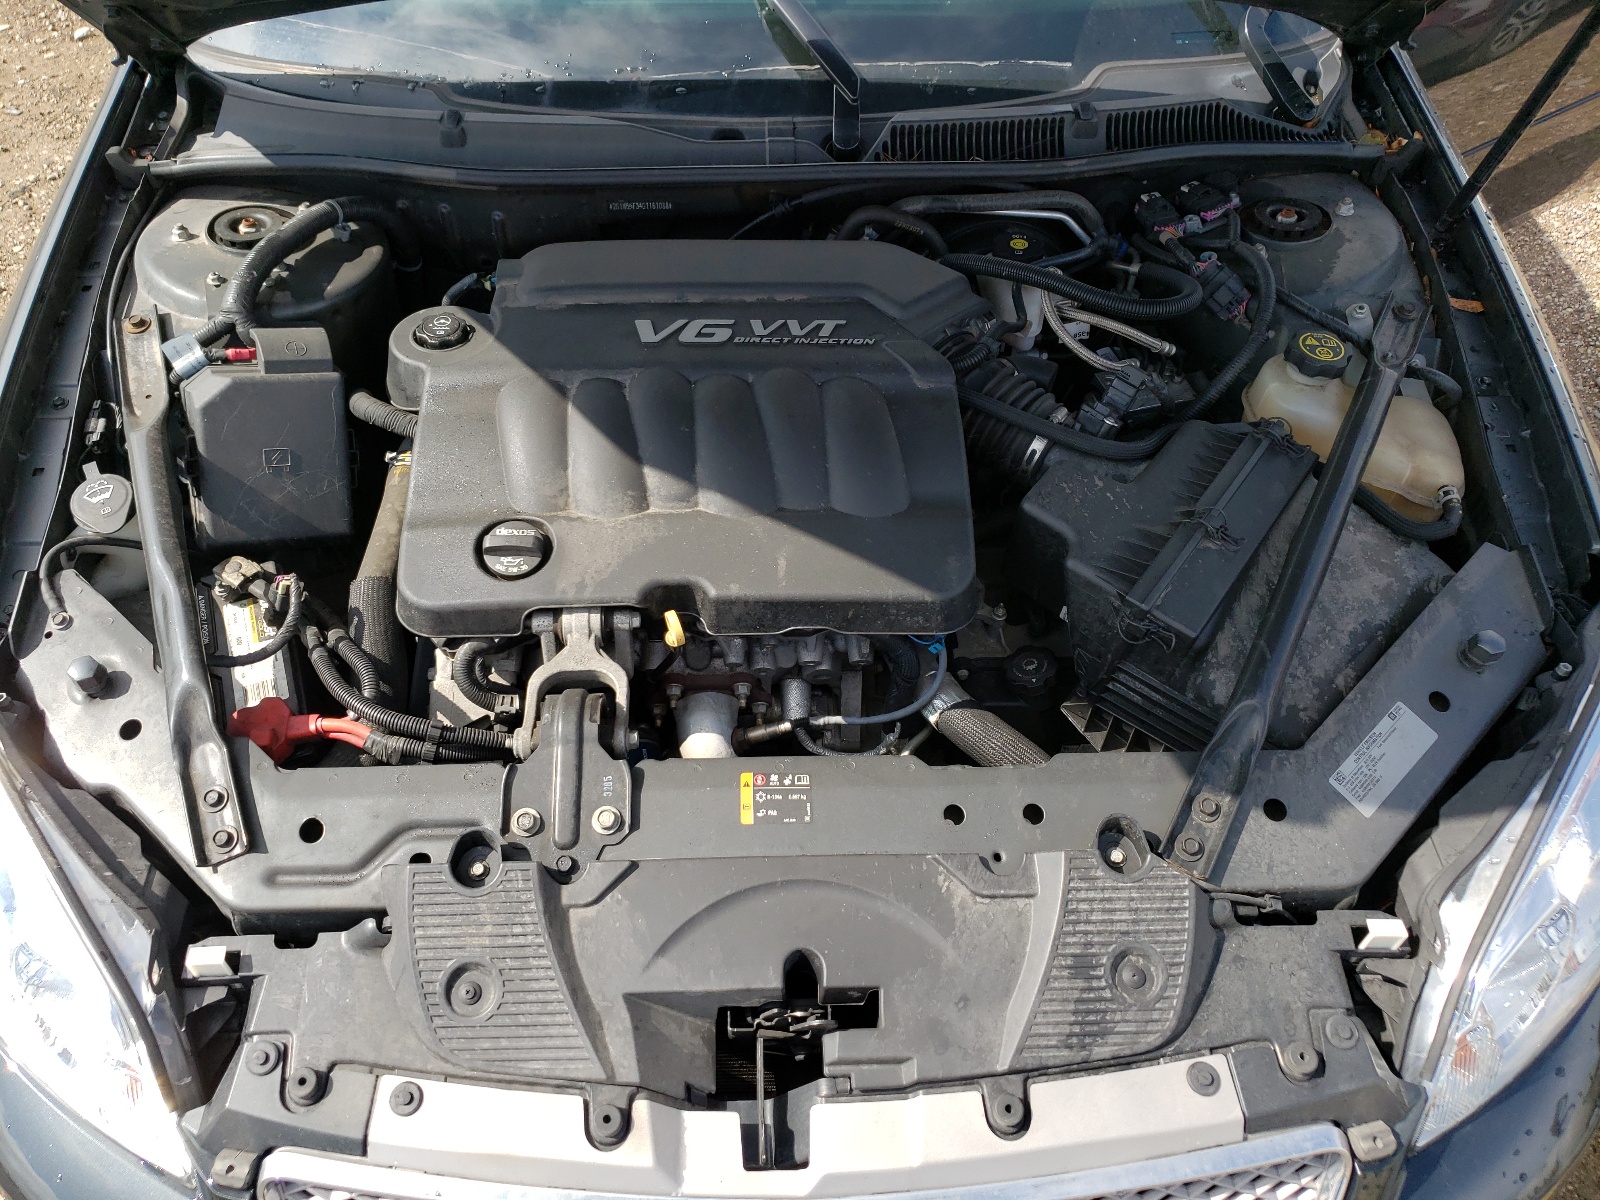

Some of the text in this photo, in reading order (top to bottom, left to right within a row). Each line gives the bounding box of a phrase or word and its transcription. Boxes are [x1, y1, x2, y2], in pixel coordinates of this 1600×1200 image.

[635, 319, 847, 344] V6 VVT
[733, 336, 876, 345] DIRECT INJECTION
[495, 527, 537, 536] dexos
